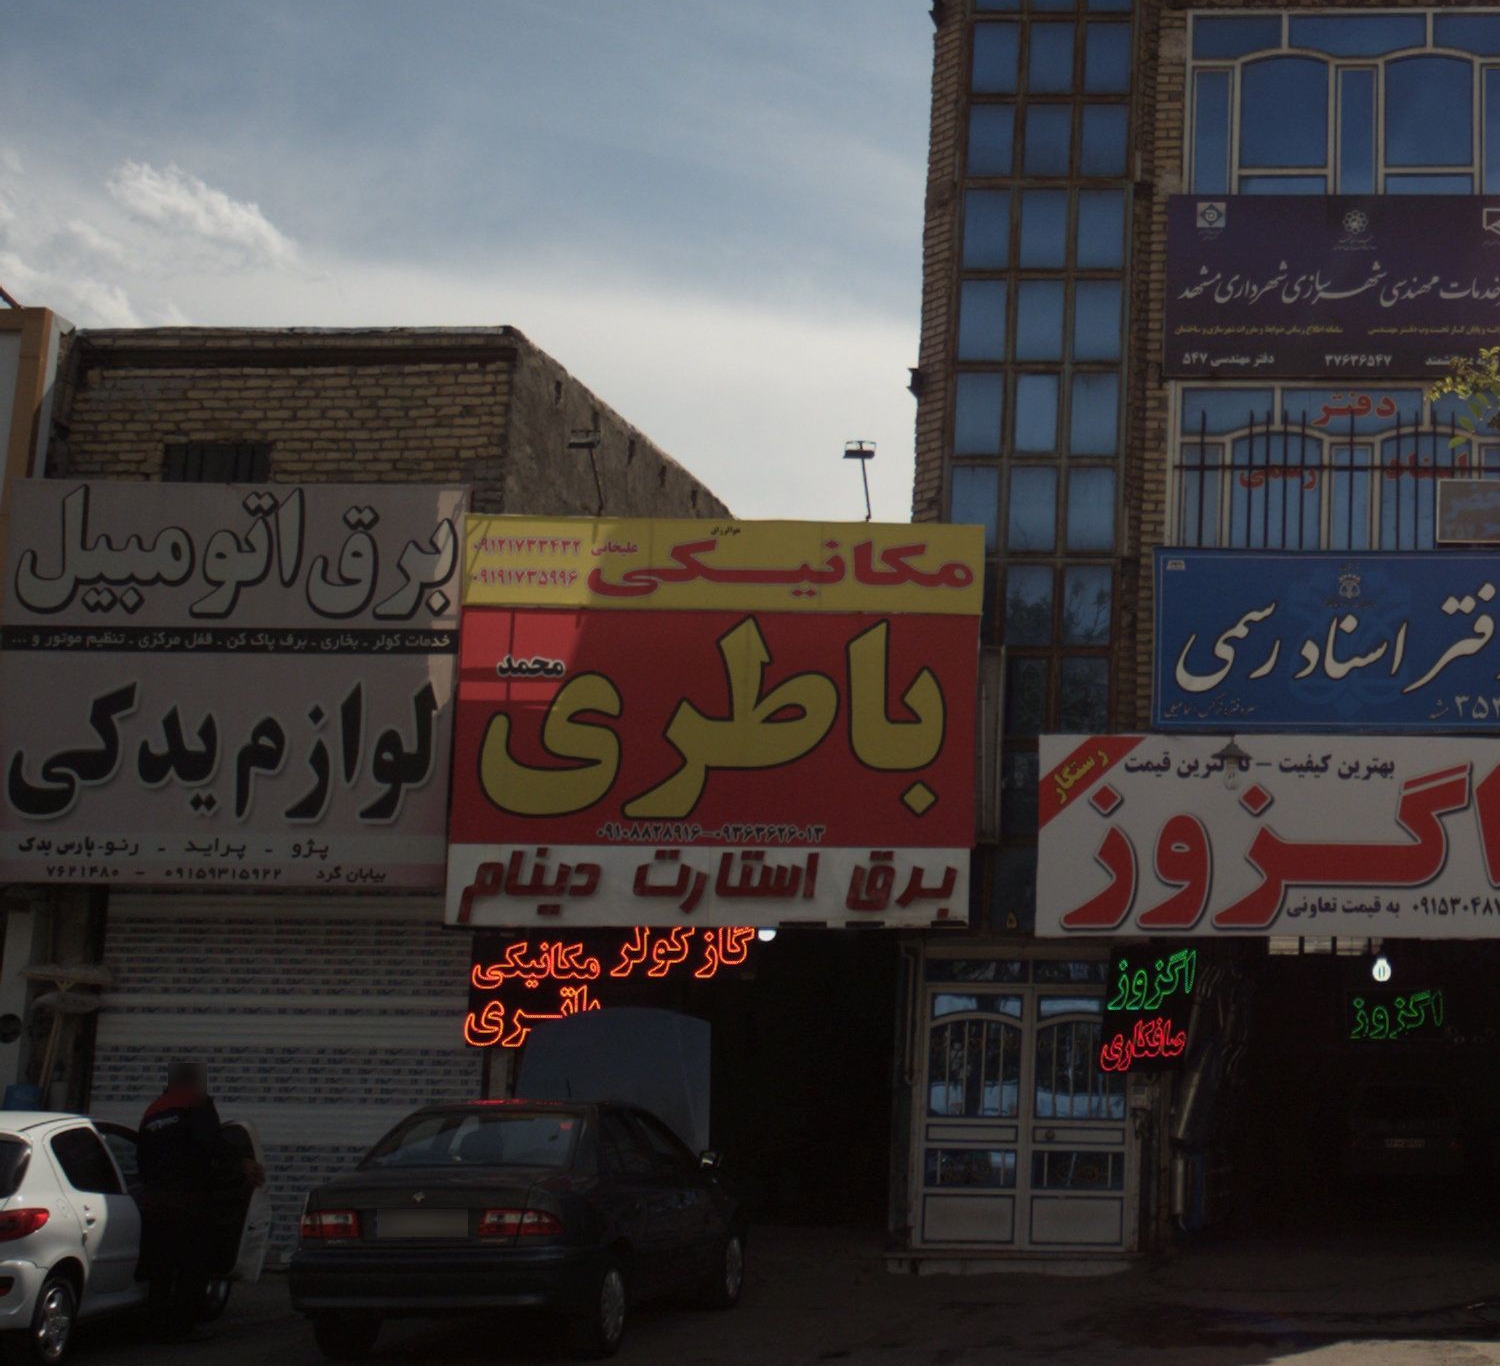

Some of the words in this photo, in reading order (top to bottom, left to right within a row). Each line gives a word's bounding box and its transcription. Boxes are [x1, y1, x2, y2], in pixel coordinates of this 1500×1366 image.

[1176, 265, 1221, 300] مشهد
[1379, 275, 1440, 309] مهندسی
[1311, 392, 1396, 427] دفتر
[14, 482, 305, 620] اتومبیل
[305, 505, 459, 621] برق
[586, 538, 974, 598] مکانیکی
[44, 633, 82, 648] موتور
[85, 632, 125, 648] تنظیم
[137, 632, 180, 649] مرکزی
[184, 632, 213, 649] قفل
[226, 633, 247, 649] کن
[250, 633, 276, 650] پاک
[279, 634, 308, 650] برف
[319, 634, 360, 650] بخاری
[371, 634, 401, 651] کولر
[404, 633, 451, 648] خدمات
[1174, 602, 1281, 693] رسمی
[1294, 614, 1408, 680] اسناد
[497, 654, 565, 676] محمد
[477, 613, 947, 820] باطری
[6, 680, 219, 820] یدکی
[234, 680, 438, 823] لوازم
[1123, 751, 1172, 777] قیمت
[1278, 752, 1333, 778] کیفیت
[1053, 748, 1111, 806] رستگار
[1337, 755, 1396, 781] بهترین
[184, 838, 246, 860] پراید
[291, 838, 329, 861] پژو
[46, 865, 120, 877] ۷۶۲۱۴۸۰
[345, 867, 386, 883] بیابان
[456, 847, 603, 923] دینام
[632, 849, 820, 914] استارت
[845, 850, 958, 920] برق
[1285, 895, 1338, 919] تعاونی
[1341, 896, 1382, 918] قیمت
[1385, 897, 1401, 918] به
[472, 941, 601, 990] مکانیکی
[610, 926, 696, 977] کولر
[694, 926, 755, 978] گاز
[1105, 947, 1198, 1012] اگزوز
[1349, 989, 1446, 1041] اگزوز
[1099, 1014, 1189, 1073] صافکاری
